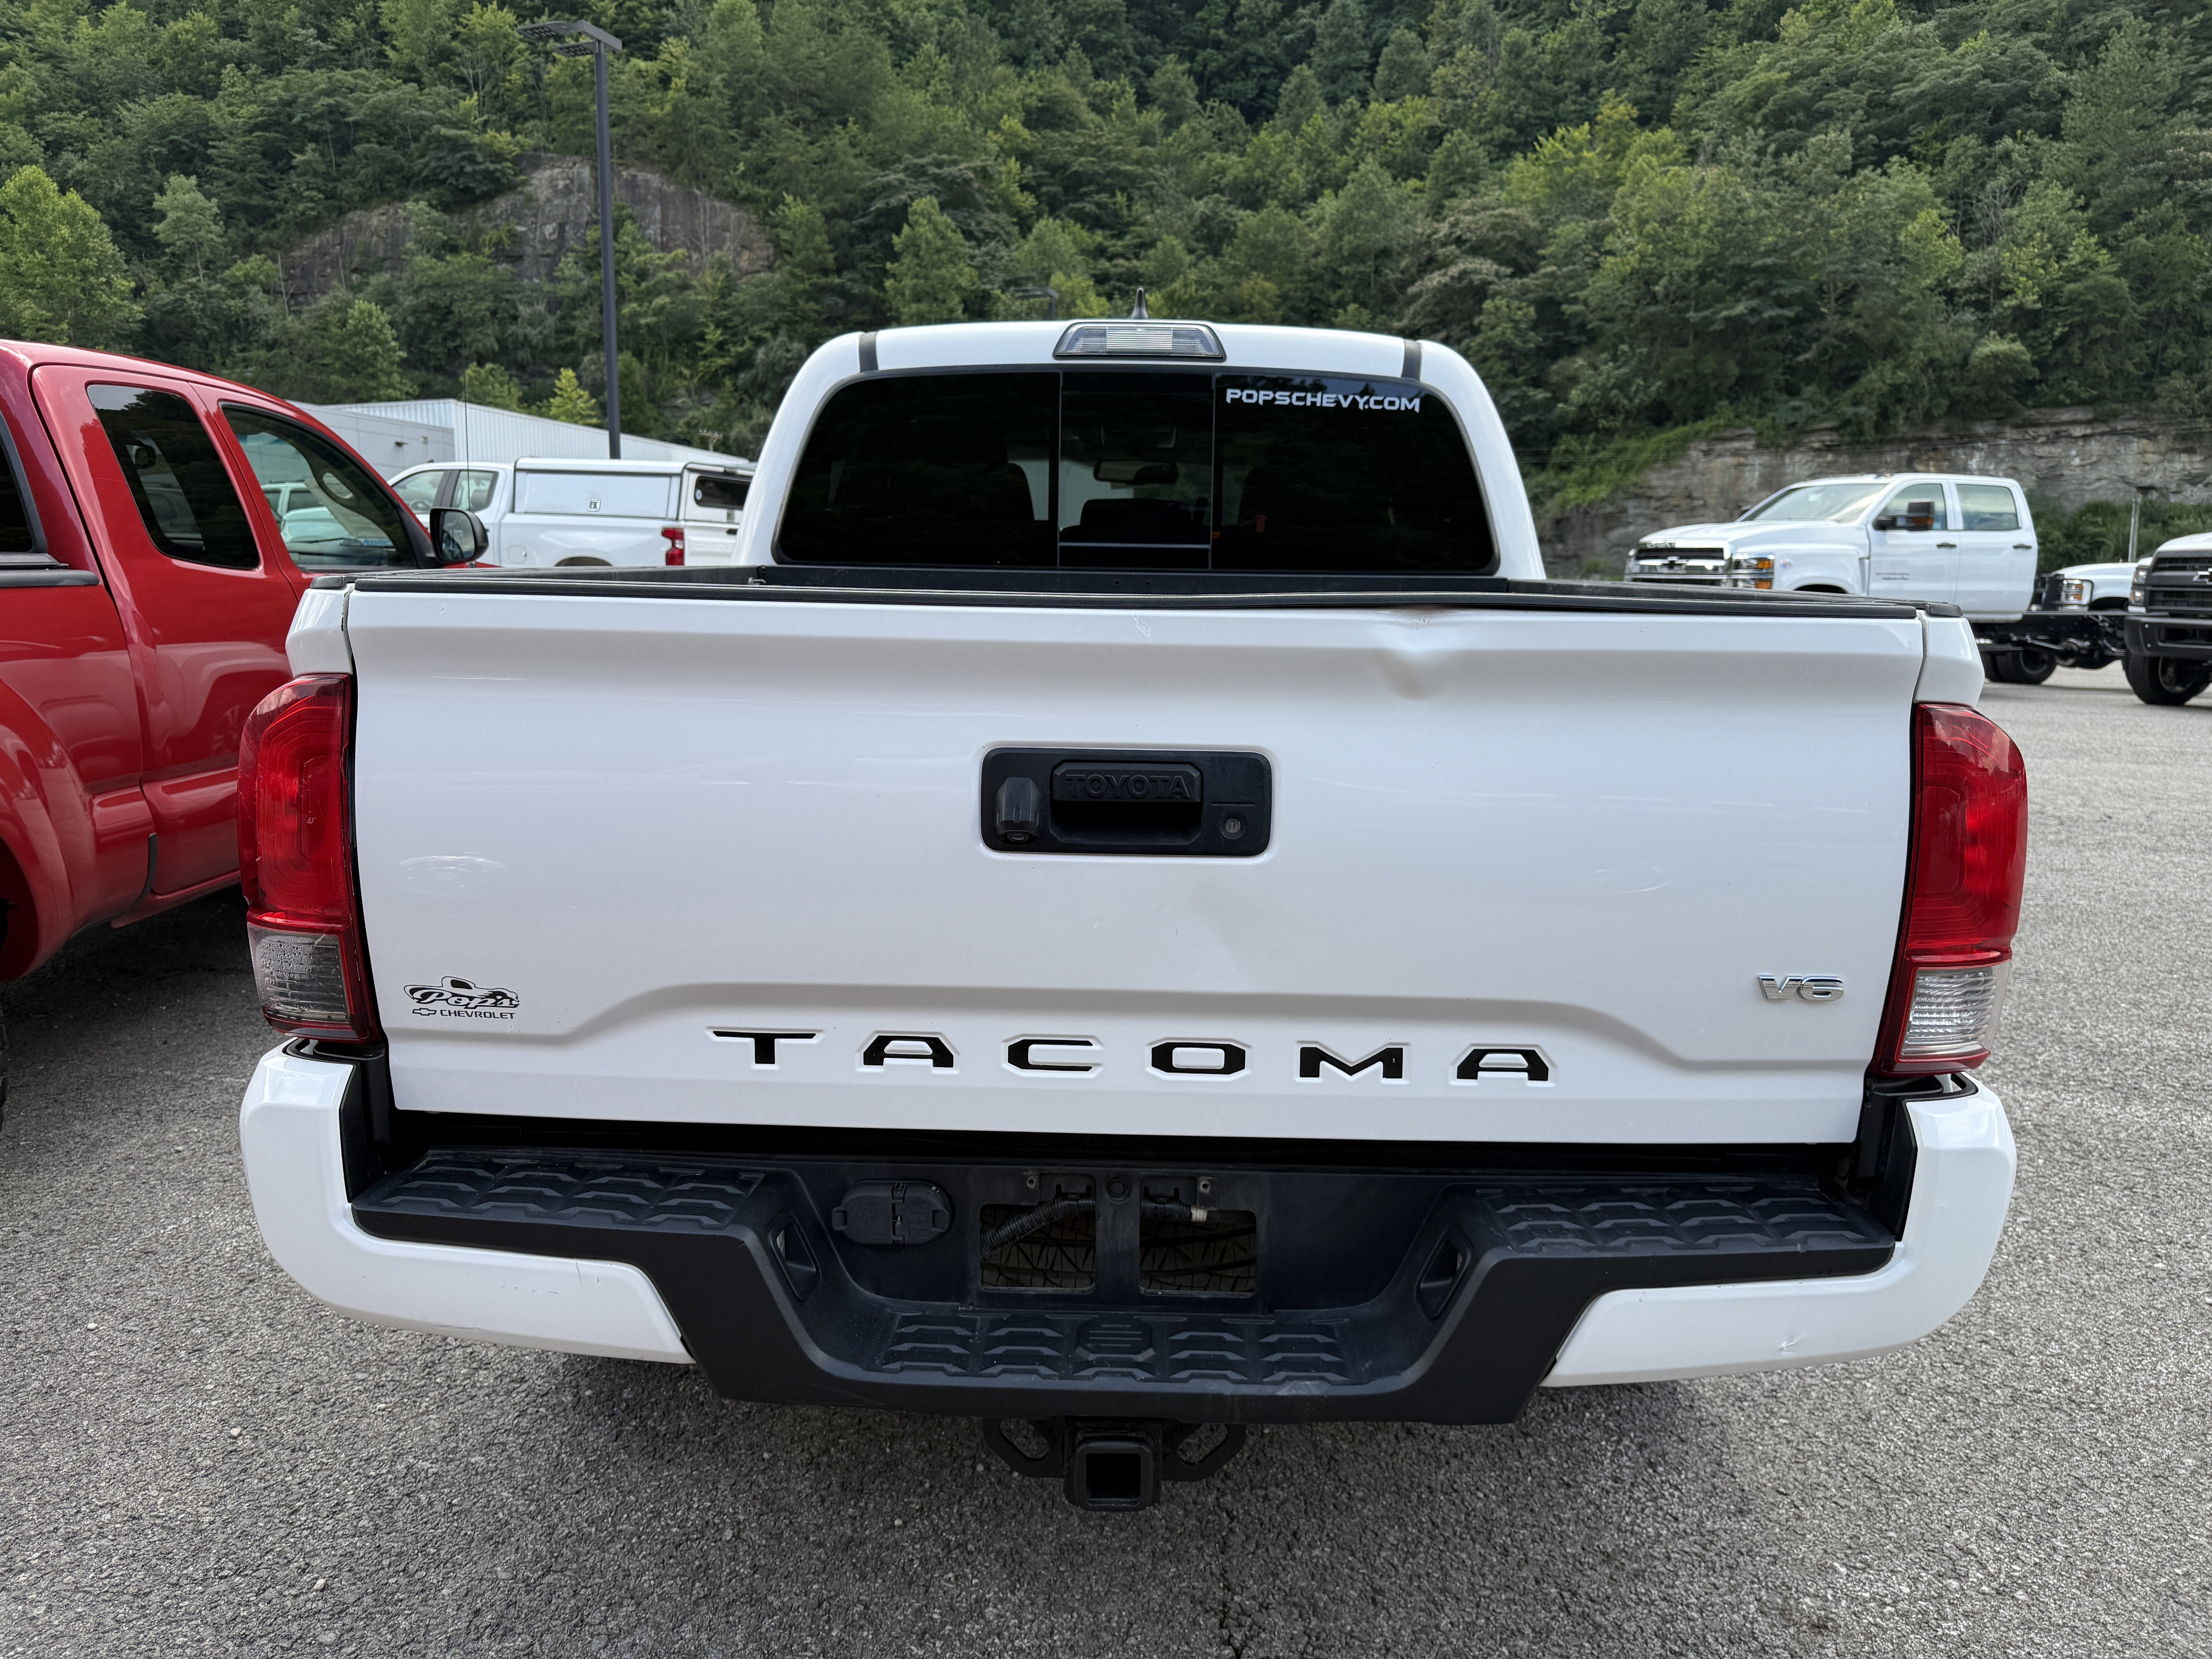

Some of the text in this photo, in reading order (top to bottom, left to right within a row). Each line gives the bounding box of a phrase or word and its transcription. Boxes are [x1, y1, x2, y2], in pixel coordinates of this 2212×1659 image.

[1226, 388, 1420, 413] POPSCHEVY.COM
[1064, 774, 1190, 799] TOYOTA
[1757, 975, 1844, 1001] V6
[440, 1010, 515, 1019] CHEVROLET
[711, 1029, 1551, 1083] TACOMA
